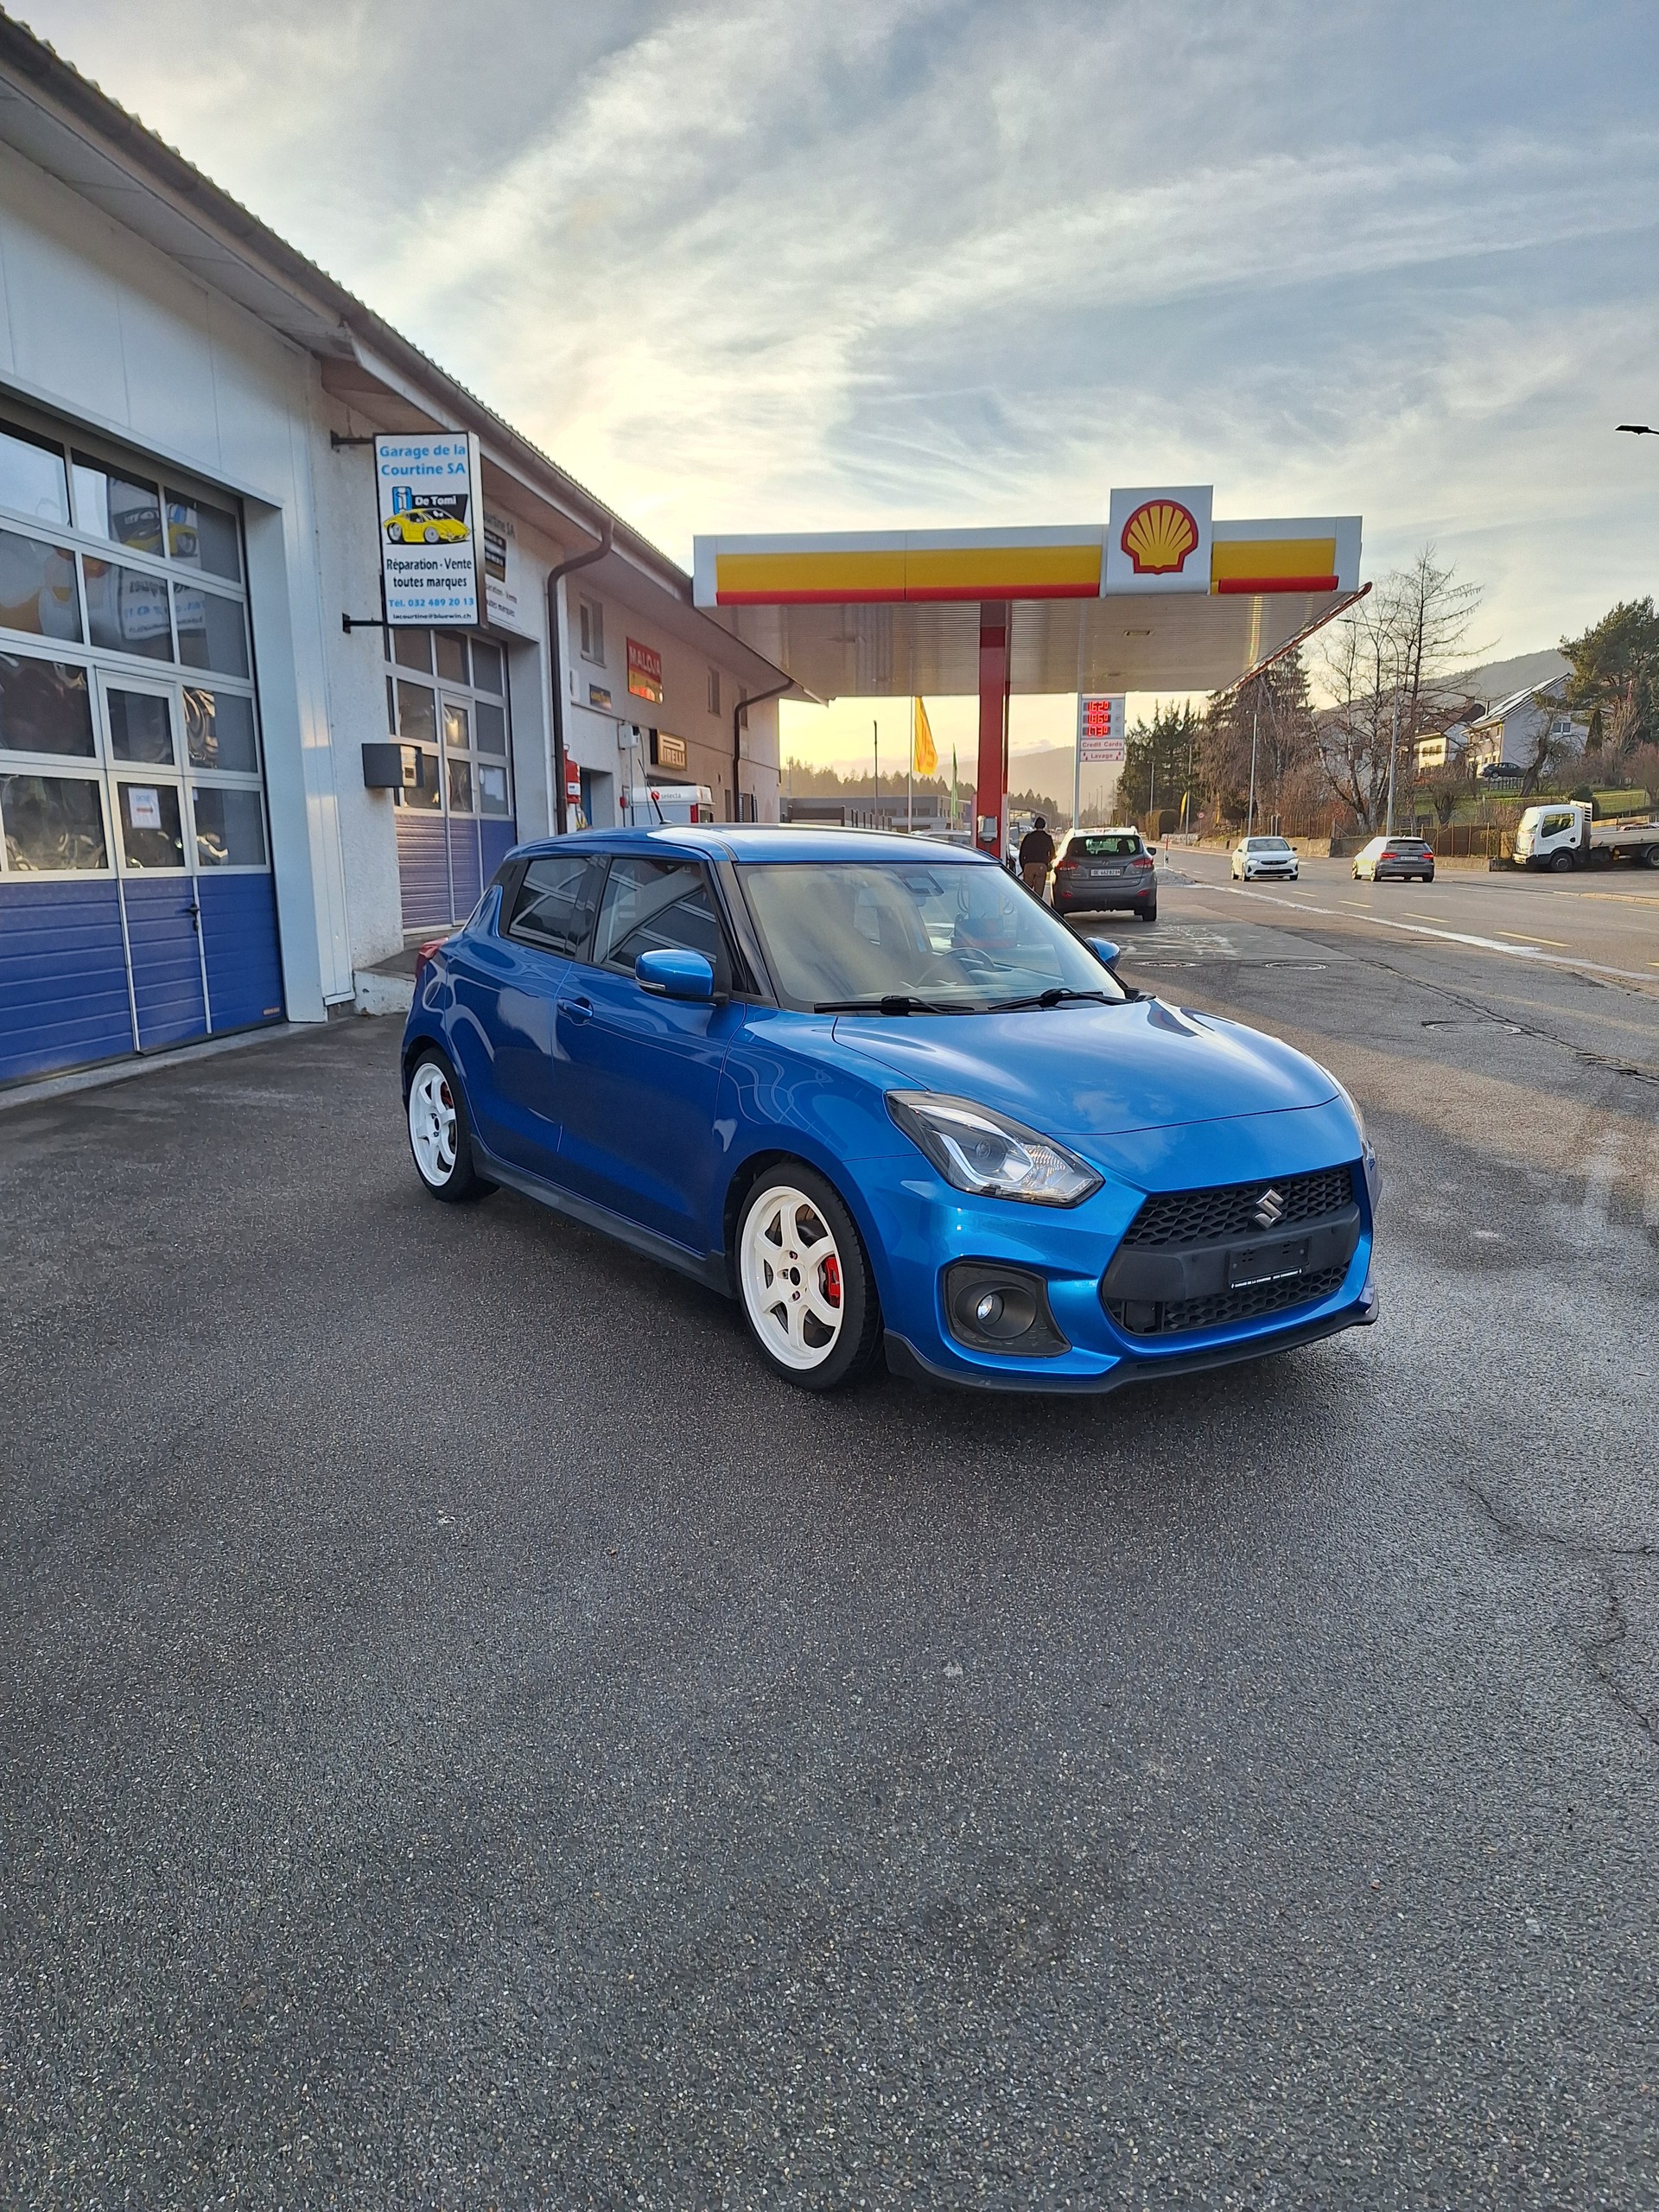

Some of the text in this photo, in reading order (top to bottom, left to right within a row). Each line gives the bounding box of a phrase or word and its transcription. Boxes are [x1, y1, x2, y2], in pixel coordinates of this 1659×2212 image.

[380, 444, 466, 459] Garage de la
[381, 463, 465, 476] Courtine SA
[415, 497, 430, 506] De
[387, 558, 438, 573] Réparation
[444, 558, 472, 570] Vente
[393, 577, 467, 590] toutes marques
[408, 599, 425, 607] 032
[428, 598, 445, 607] 489
[449, 598, 460, 606] 20
[630, 646, 660, 676] MALOJA
[660, 736, 685, 765] PIRELLI
